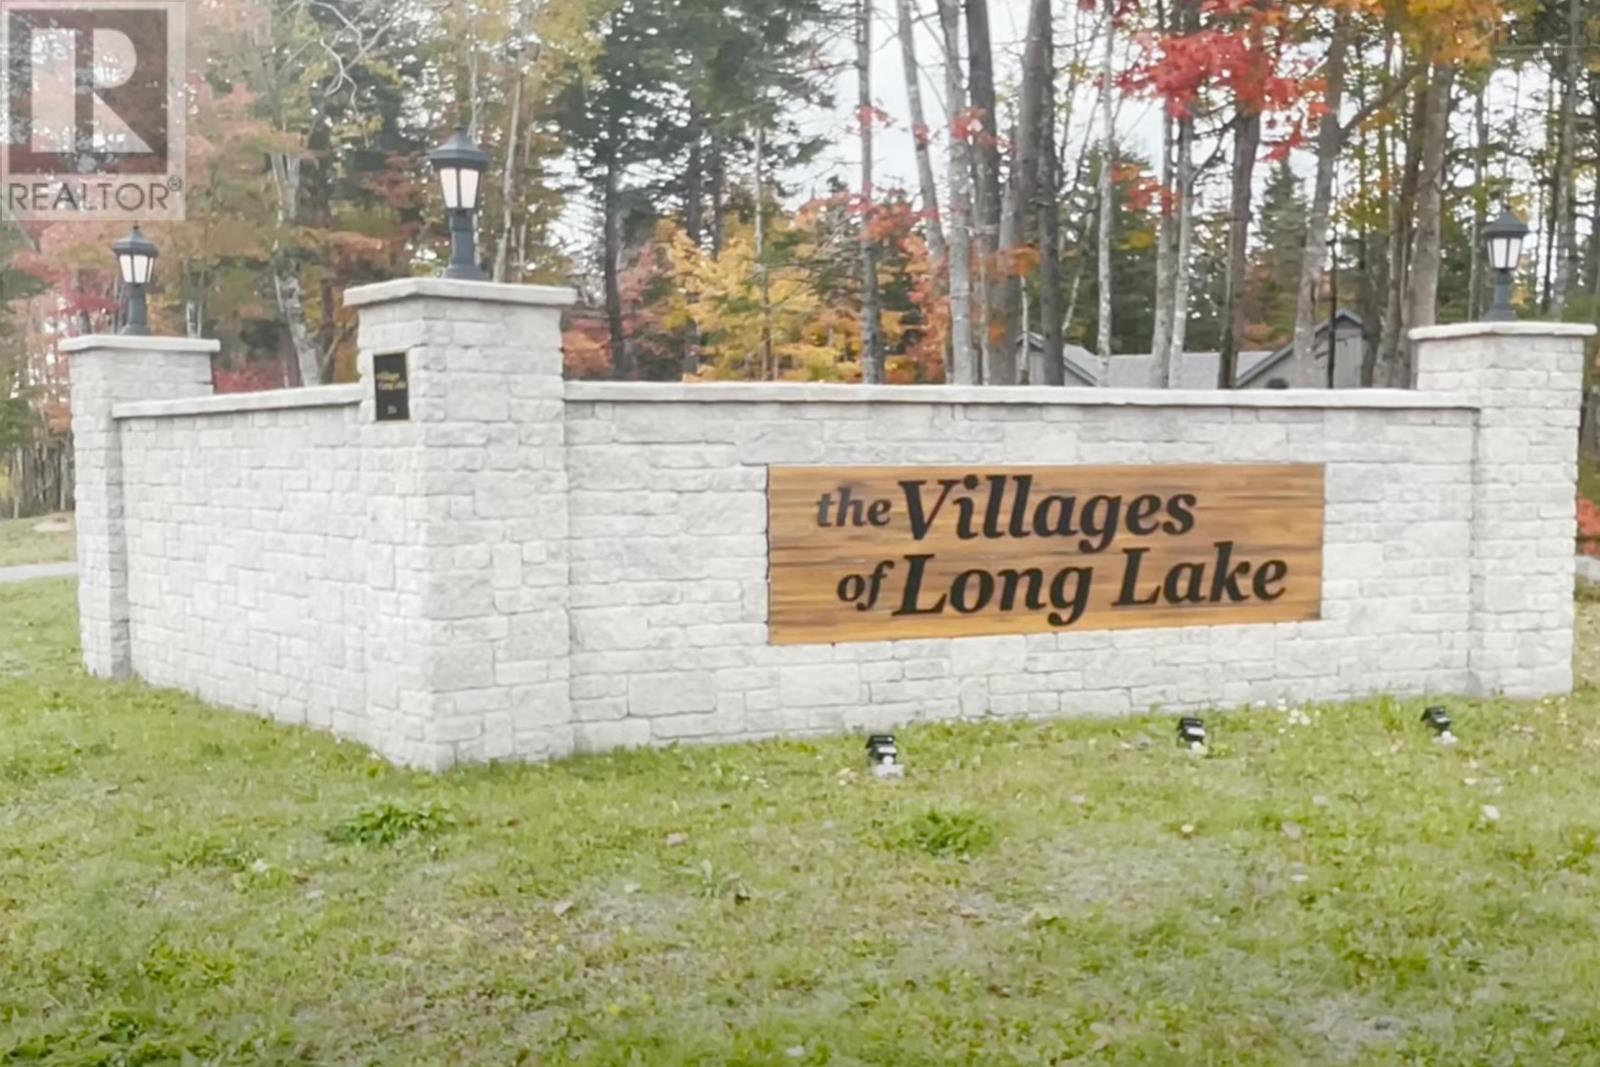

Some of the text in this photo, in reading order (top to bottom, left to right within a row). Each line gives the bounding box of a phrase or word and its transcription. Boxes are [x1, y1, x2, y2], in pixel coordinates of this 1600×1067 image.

[816, 474, 1198, 553] the Villages
[836, 541, 1289, 627] of Long Lake
